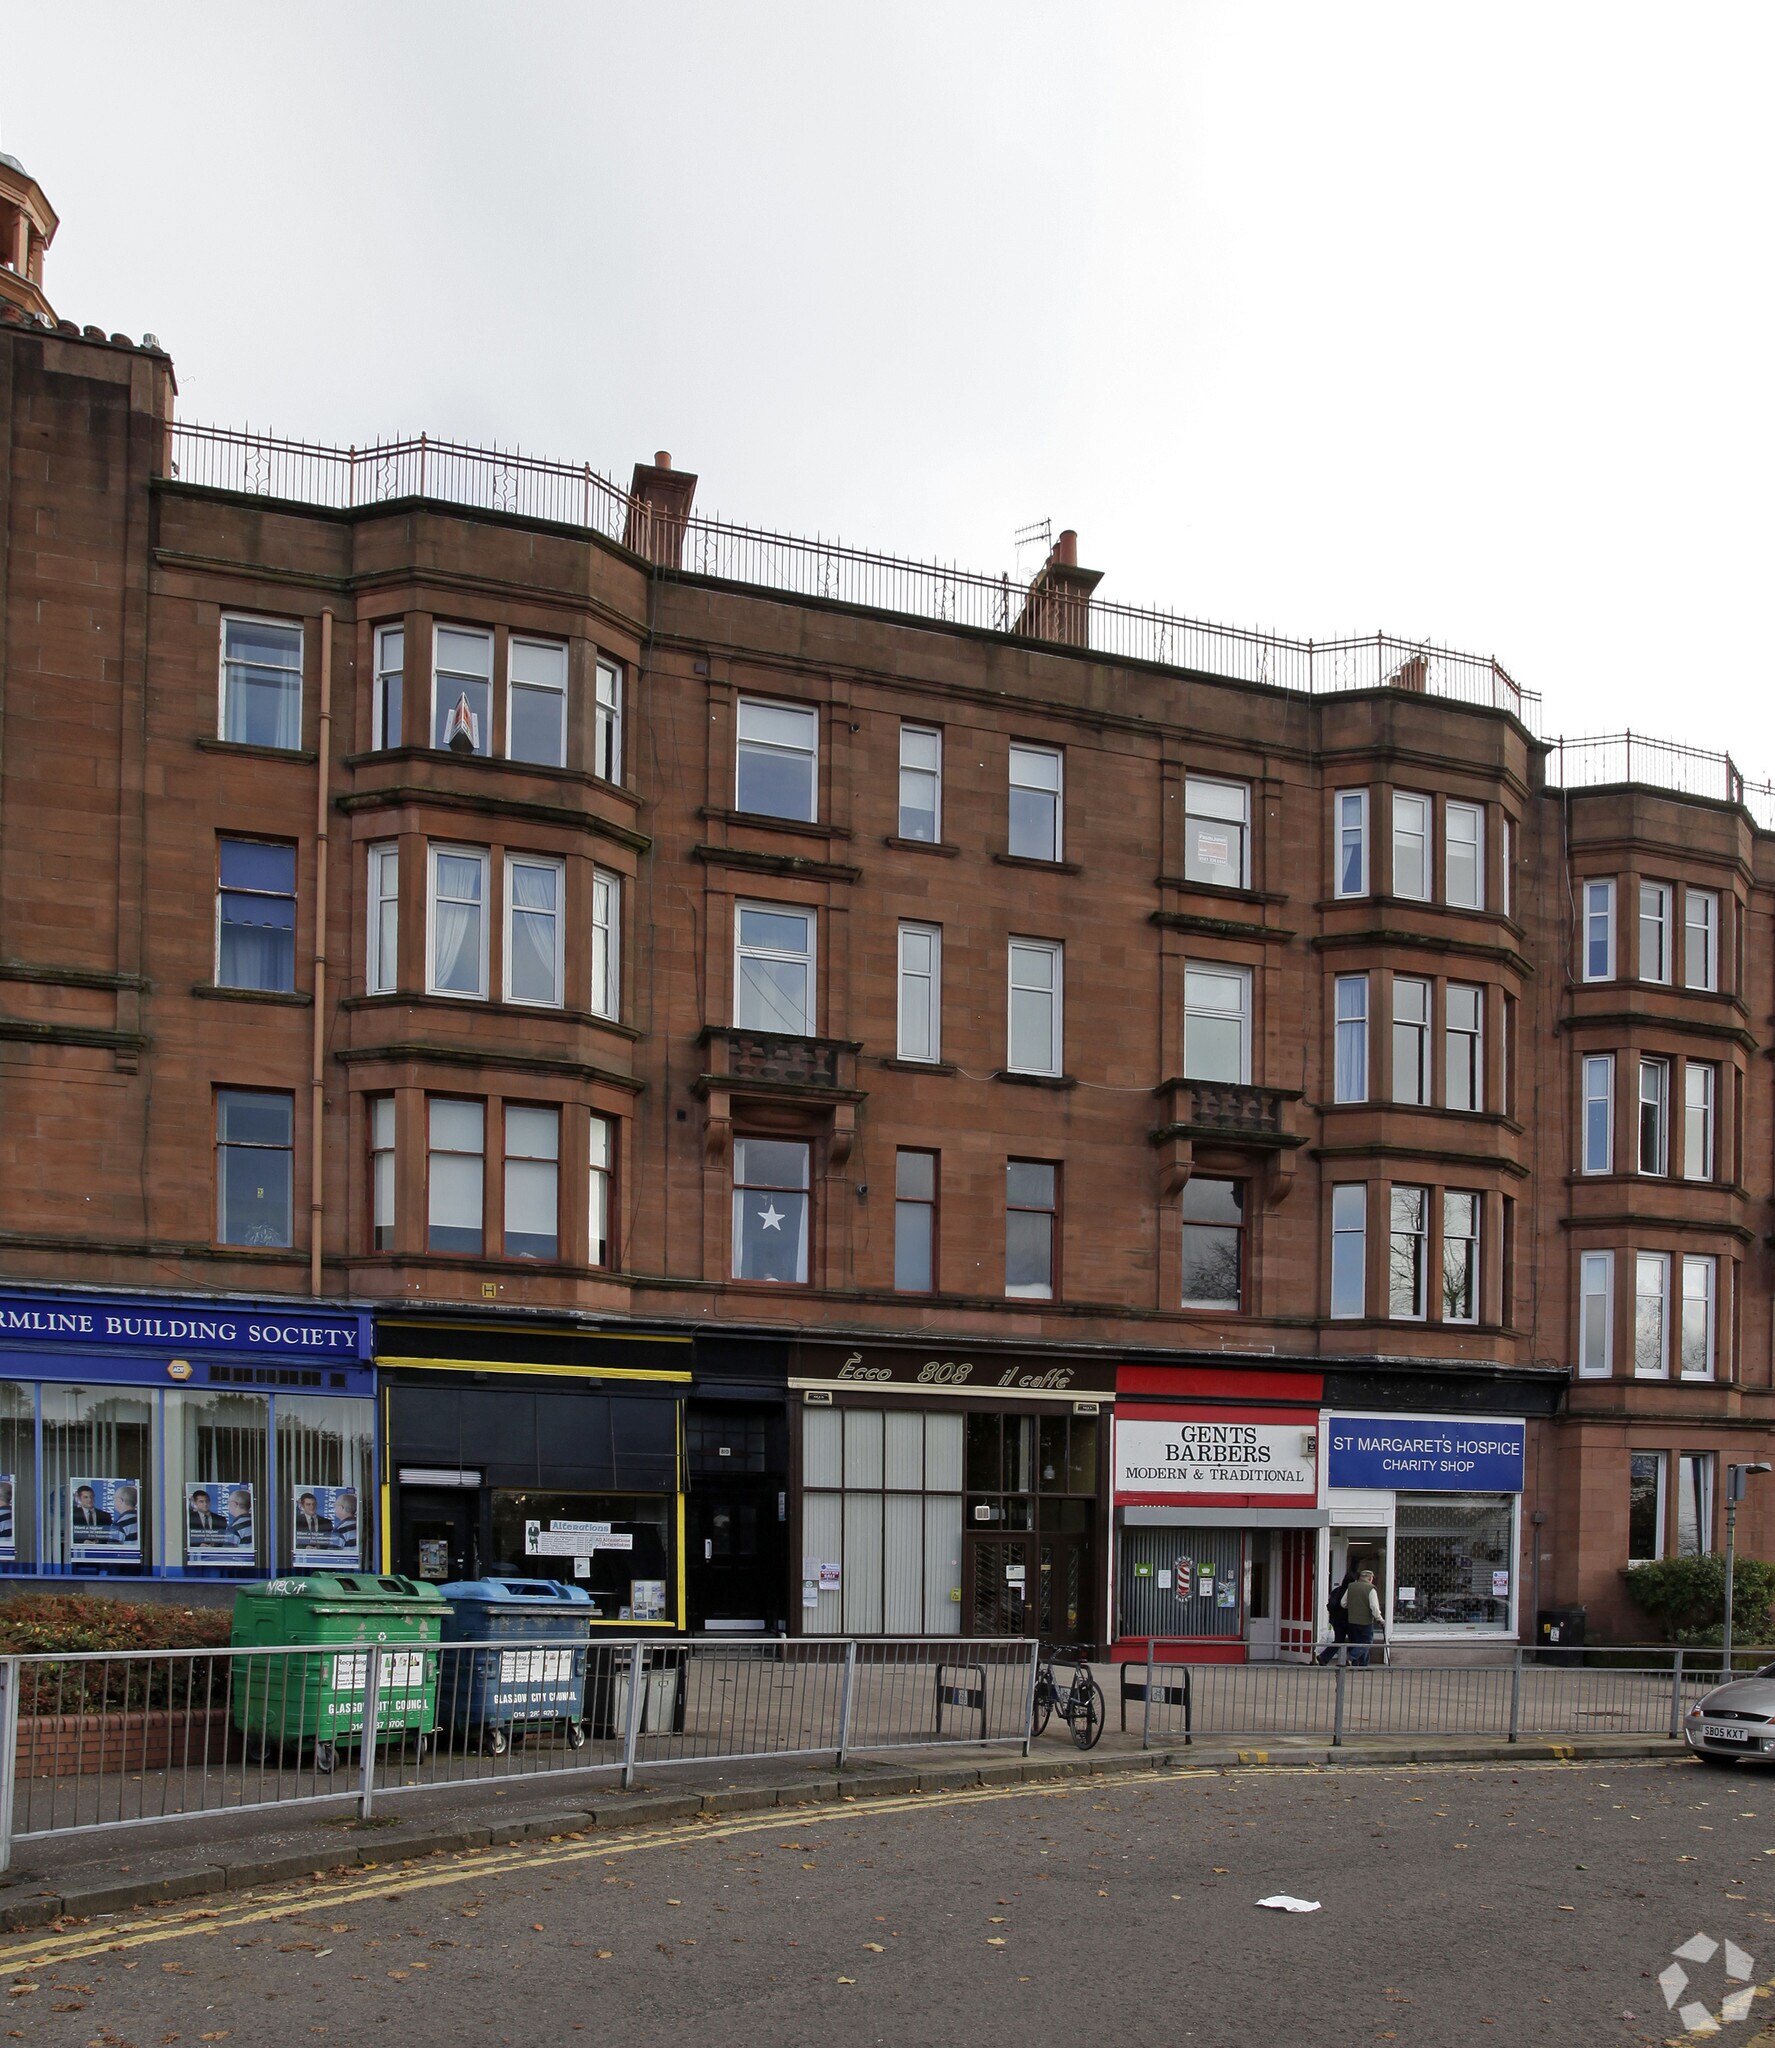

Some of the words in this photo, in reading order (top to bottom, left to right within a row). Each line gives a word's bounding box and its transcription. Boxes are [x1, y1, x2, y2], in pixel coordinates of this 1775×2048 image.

[106, 1316, 236, 1341] BUILDING
[249, 1324, 357, 1347] SOCIETY
[917, 1361, 974, 1385] 808
[998, 1366, 1020, 1387] il
[1018, 1367, 1076, 1389] caffè
[1181, 1425, 1257, 1444] GENTS
[1165, 1444, 1271, 1463] BARBERS
[1333, 1437, 1354, 1451] ST
[1358, 1434, 1453, 1453] MARGARET'S
[1456, 1440, 1521, 1456] HOSPICE
[1382, 1458, 1438, 1471] CHARITY
[1440, 1460, 1475, 1472] SHOP
[1125, 1466, 1187, 1480] MODERN
[1193, 1468, 1204, 1480] &
[1210, 1468, 1305, 1482] TRADITIONAL
[552, 1521, 610, 1532] Alterations
[328, 1702, 365, 1714] GLASGO
[396, 1699, 429, 1710] COUNCL
[1705, 1727, 1725, 1739] SB05
[1726, 1729, 1745, 1739] KXT
